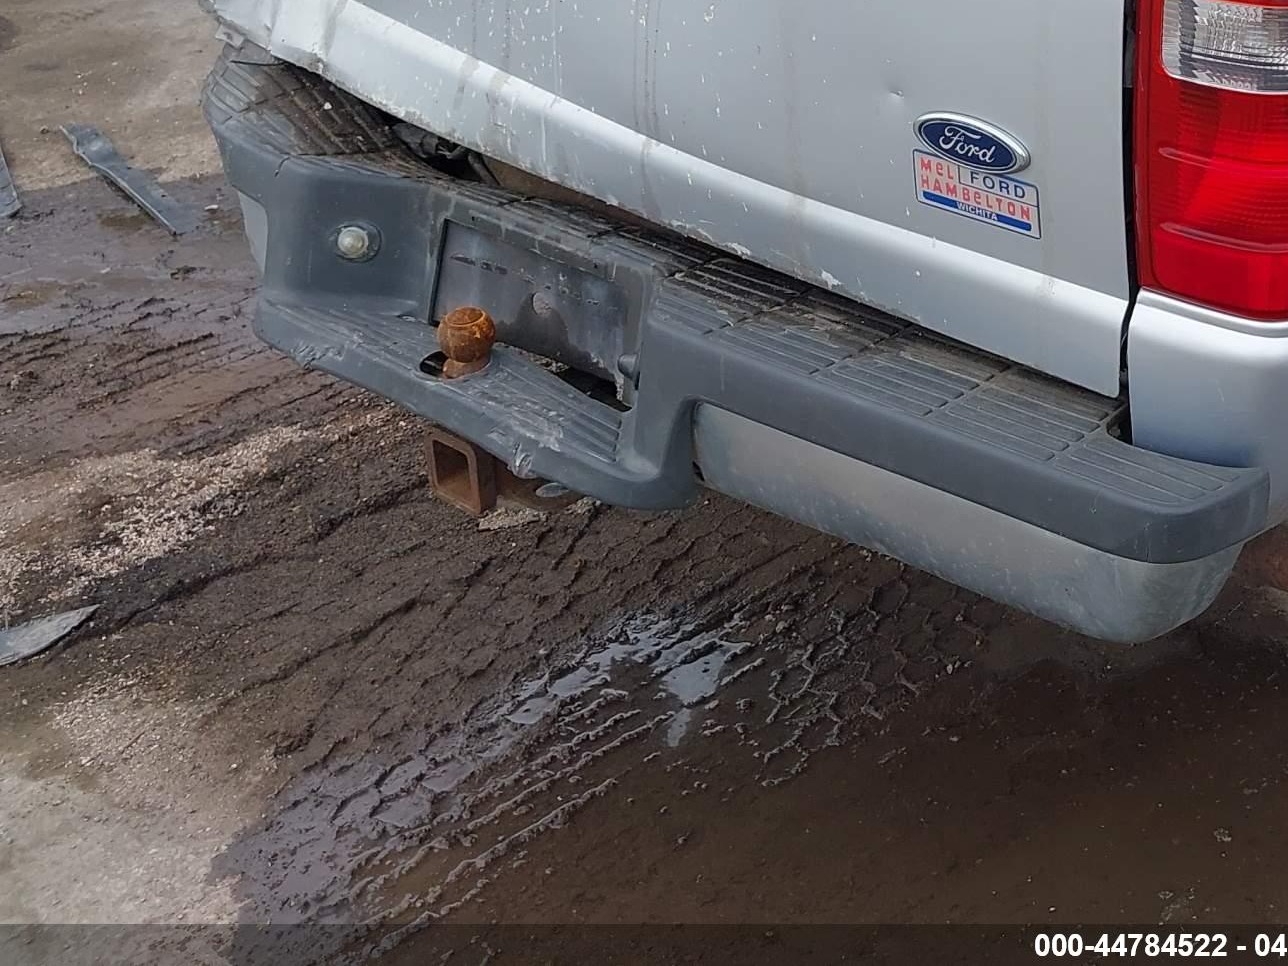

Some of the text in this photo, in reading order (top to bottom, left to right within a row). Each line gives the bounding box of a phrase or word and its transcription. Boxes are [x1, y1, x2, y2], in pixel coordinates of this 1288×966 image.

[939, 125, 997, 163] Ford
[970, 170, 1026, 199] FORD
[956, 201, 998, 221] WICHITA
